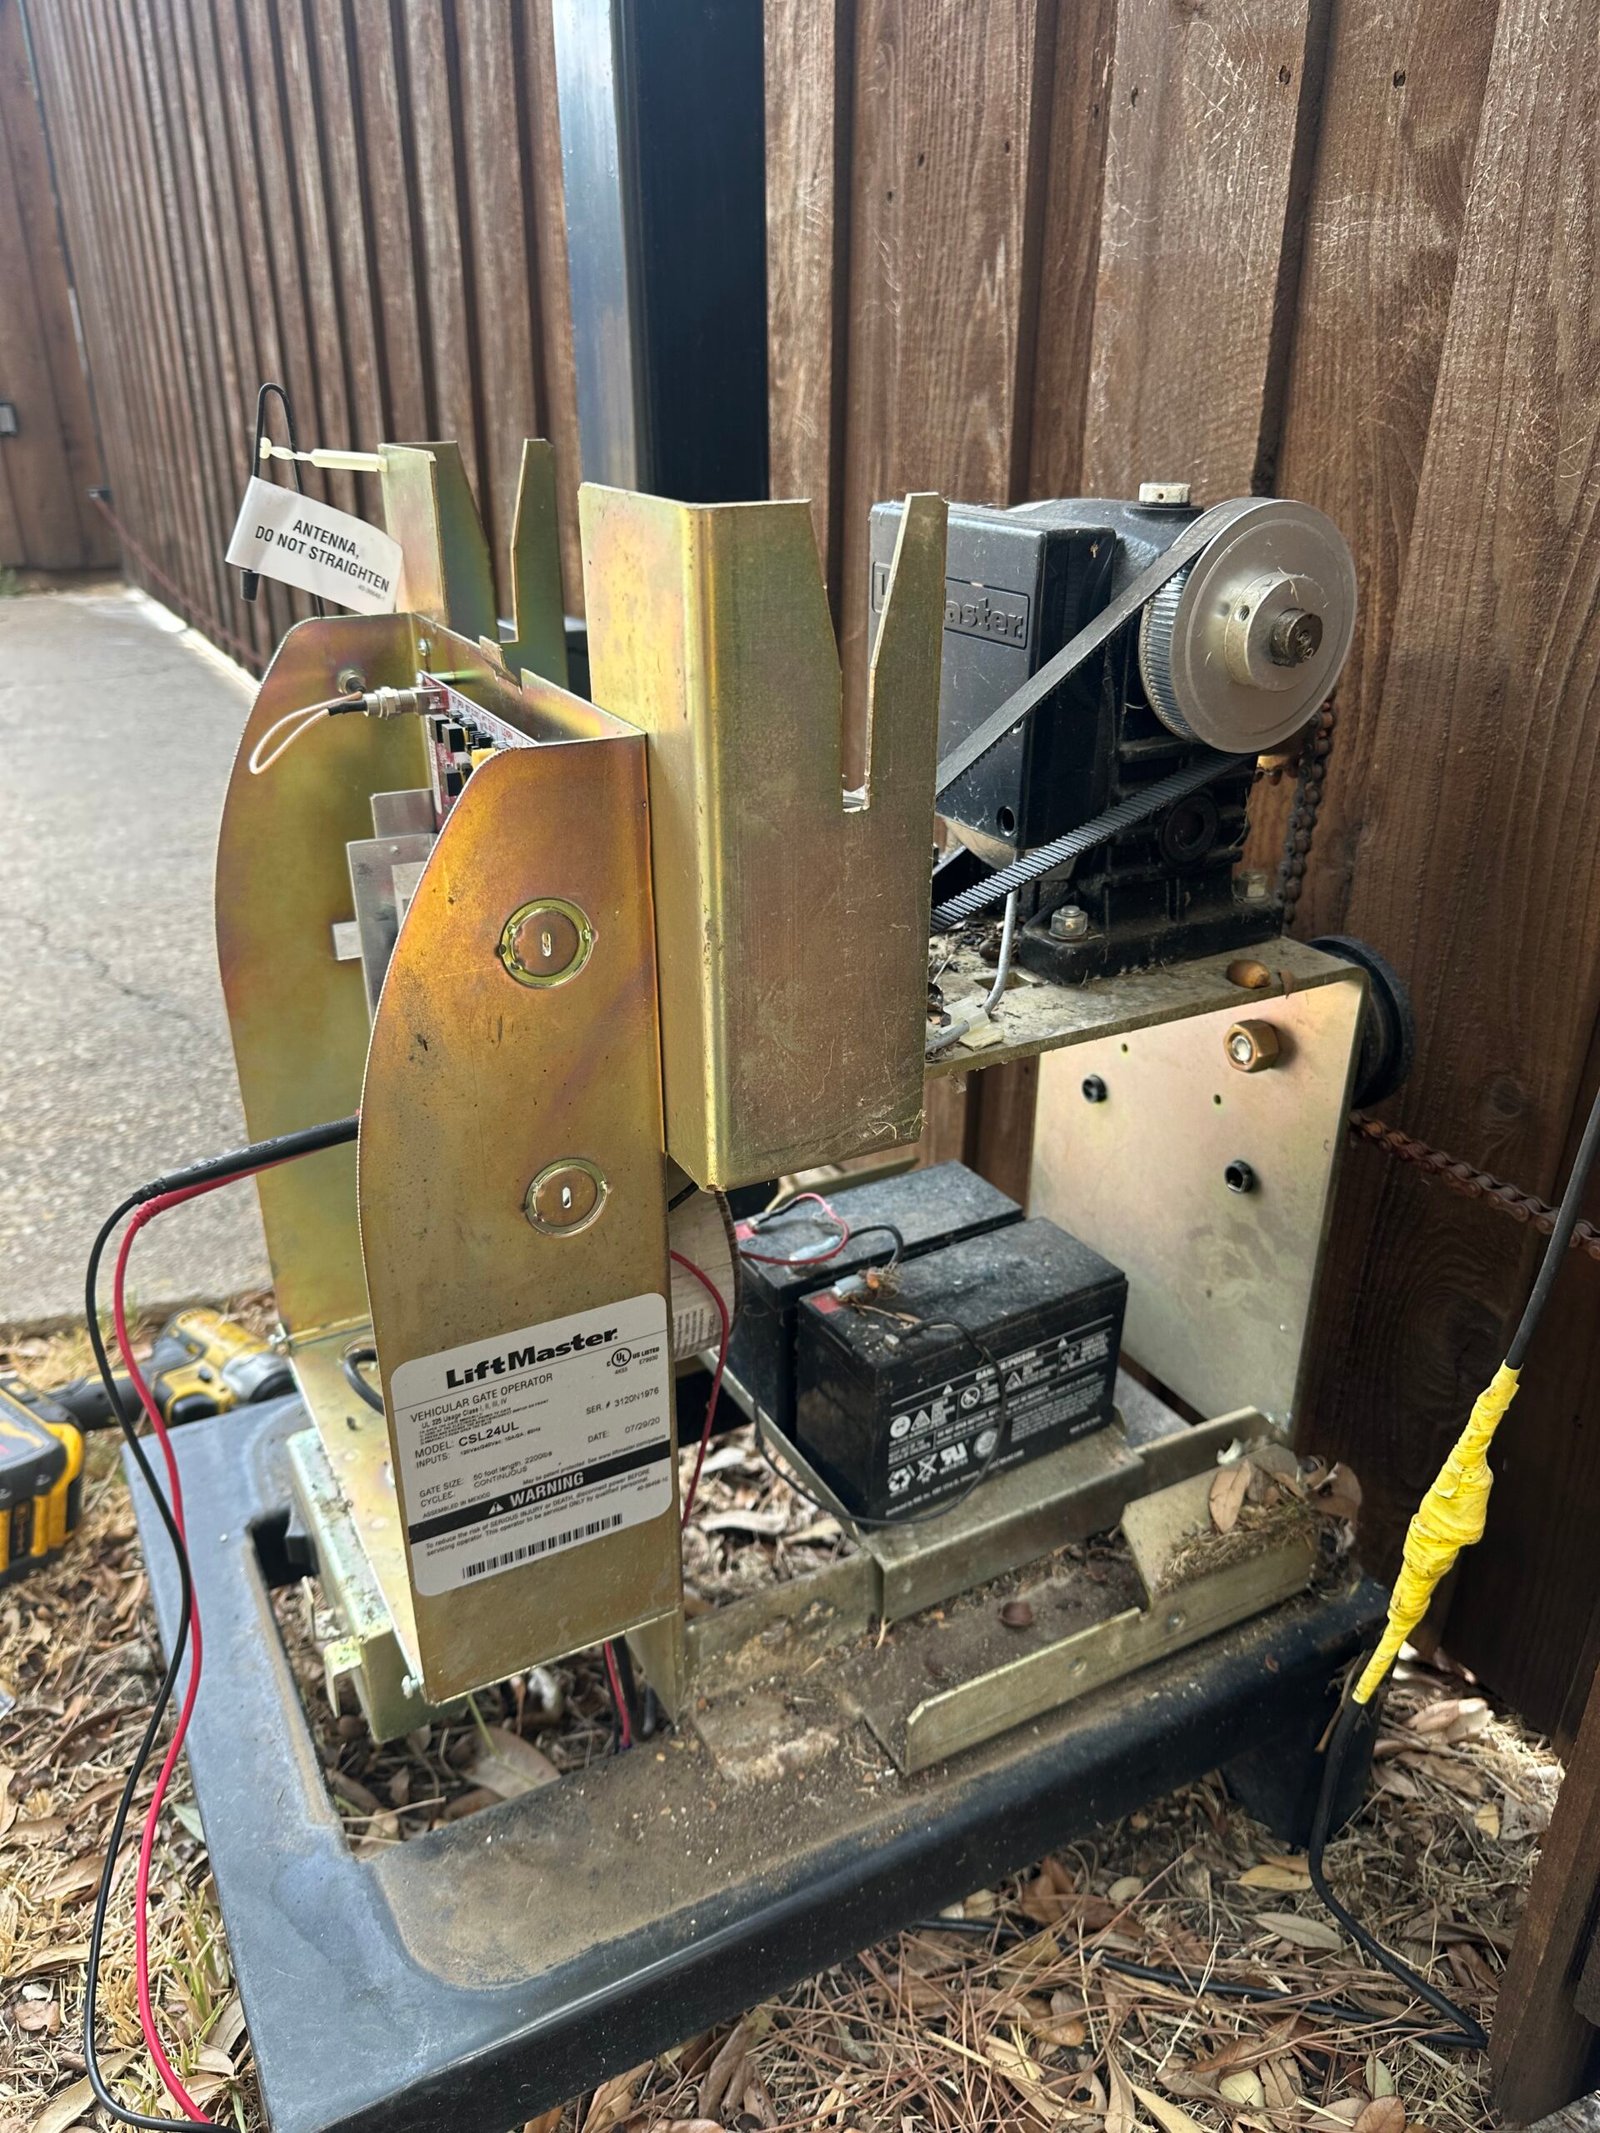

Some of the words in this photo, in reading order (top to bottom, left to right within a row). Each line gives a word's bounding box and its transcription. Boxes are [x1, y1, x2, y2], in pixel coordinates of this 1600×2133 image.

[293, 520, 360, 560] ANTENNA,
[255, 526, 274, 542] DO
[277, 533, 307, 555] NOT
[309, 546, 390, 593] STRAIGHTEN
[616, 1350, 626, 1364] UL
[641, 1346, 659, 1356] LISTED
[409, 1397, 469, 1422] VEHICULAR
[472, 1388, 497, 1404] GATE
[500, 1372, 552, 1395] OPERATOR
[614, 1386, 659, 1407] 3120N1976
[421, 1421, 430, 1429] UL
[432, 1417, 441, 1425] 325
[443, 1412, 461, 1422] Usage
[462, 1407, 478, 1416] Class
[587, 1430, 606, 1443] DATE:
[624, 1416, 660, 1433] 07/29/20
[414, 1441, 453, 1458] MODEL:
[458, 1421, 519, 1446] CSL24UL
[416, 1452, 448, 1468] INPUTS:
[419, 1484, 440, 1497] GATE
[484, 1467, 497, 1476] foot
[473, 1465, 527, 1488] CONTINUOUS
[509, 1471, 583, 1507] WARNING
[422, 1502, 458, 1518] ASSEMBLED
[467, 1491, 490, 1503] MEXICO
[435, 1535, 456, 1546] reduce
[469, 1526, 480, 1534] risk
[490, 1513, 518, 1527] SERIOUS
[520, 1505, 542, 1517] INJURY
[575, 1483, 607, 1498] disconnect
[608, 1477, 625, 1489] power
[627, 1468, 649, 1480] BEFORE
[426, 1542, 455, 1556] servicing
[499, 1519, 525, 1531] operator
[543, 1503, 567, 1516] serviced
[568, 1498, 584, 1507] ONLY
[594, 1486, 618, 1499] qualified
